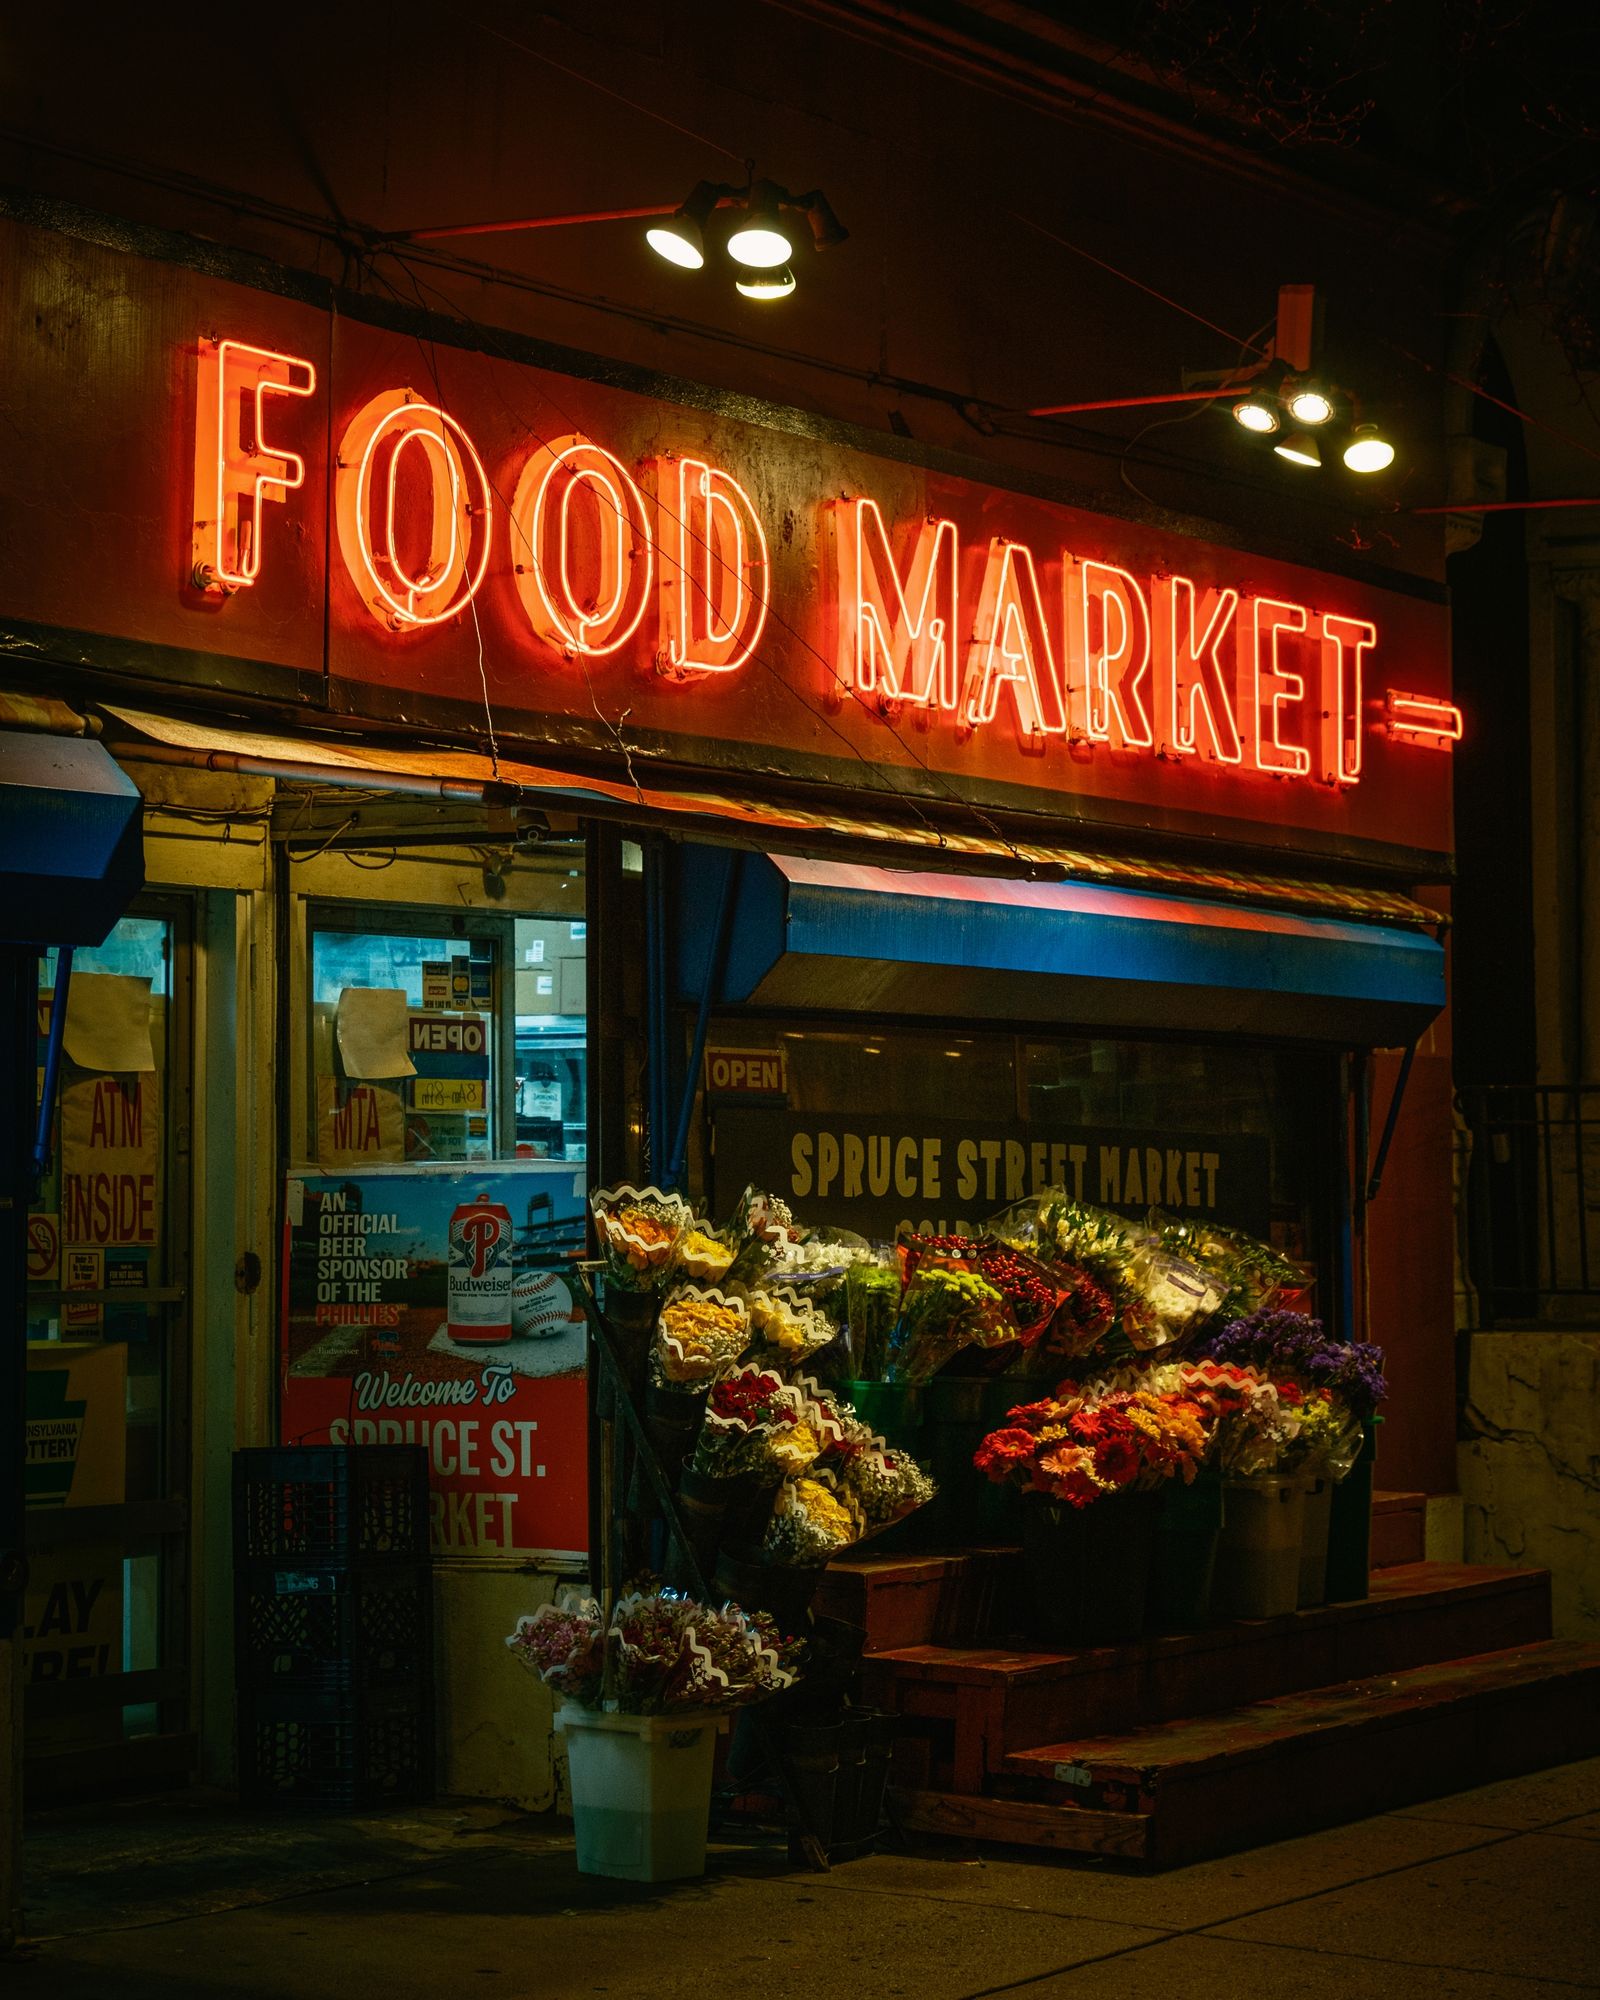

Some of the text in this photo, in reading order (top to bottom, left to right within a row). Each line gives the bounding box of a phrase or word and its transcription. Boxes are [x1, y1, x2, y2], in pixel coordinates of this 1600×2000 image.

[193, 337, 1377, 786] FOOD MARKET
[712, 1059, 779, 1089] OPEN
[90, 1082, 142, 1148] ATM
[791, 1132, 1220, 1207] SPRUCE STREET MARKET
[67, 1174, 154, 1243] INSIDE
[320, 1192, 347, 1212] AN
[319, 1214, 401, 1235] OFFICIAL
[319, 1237, 367, 1257] BEER
[316, 1259, 409, 1280] SPONSOR
[317, 1282, 382, 1303] OF THE
[449, 1276, 511, 1291] Budweiser
[353, 1363, 517, 1412] Welcome To
[25, 1421, 77, 1438] NSYLVANIA
[25, 1438, 77, 1459] TTERY
[490, 1420, 546, 1477] ST.
[430, 1491, 519, 1549] RKET
